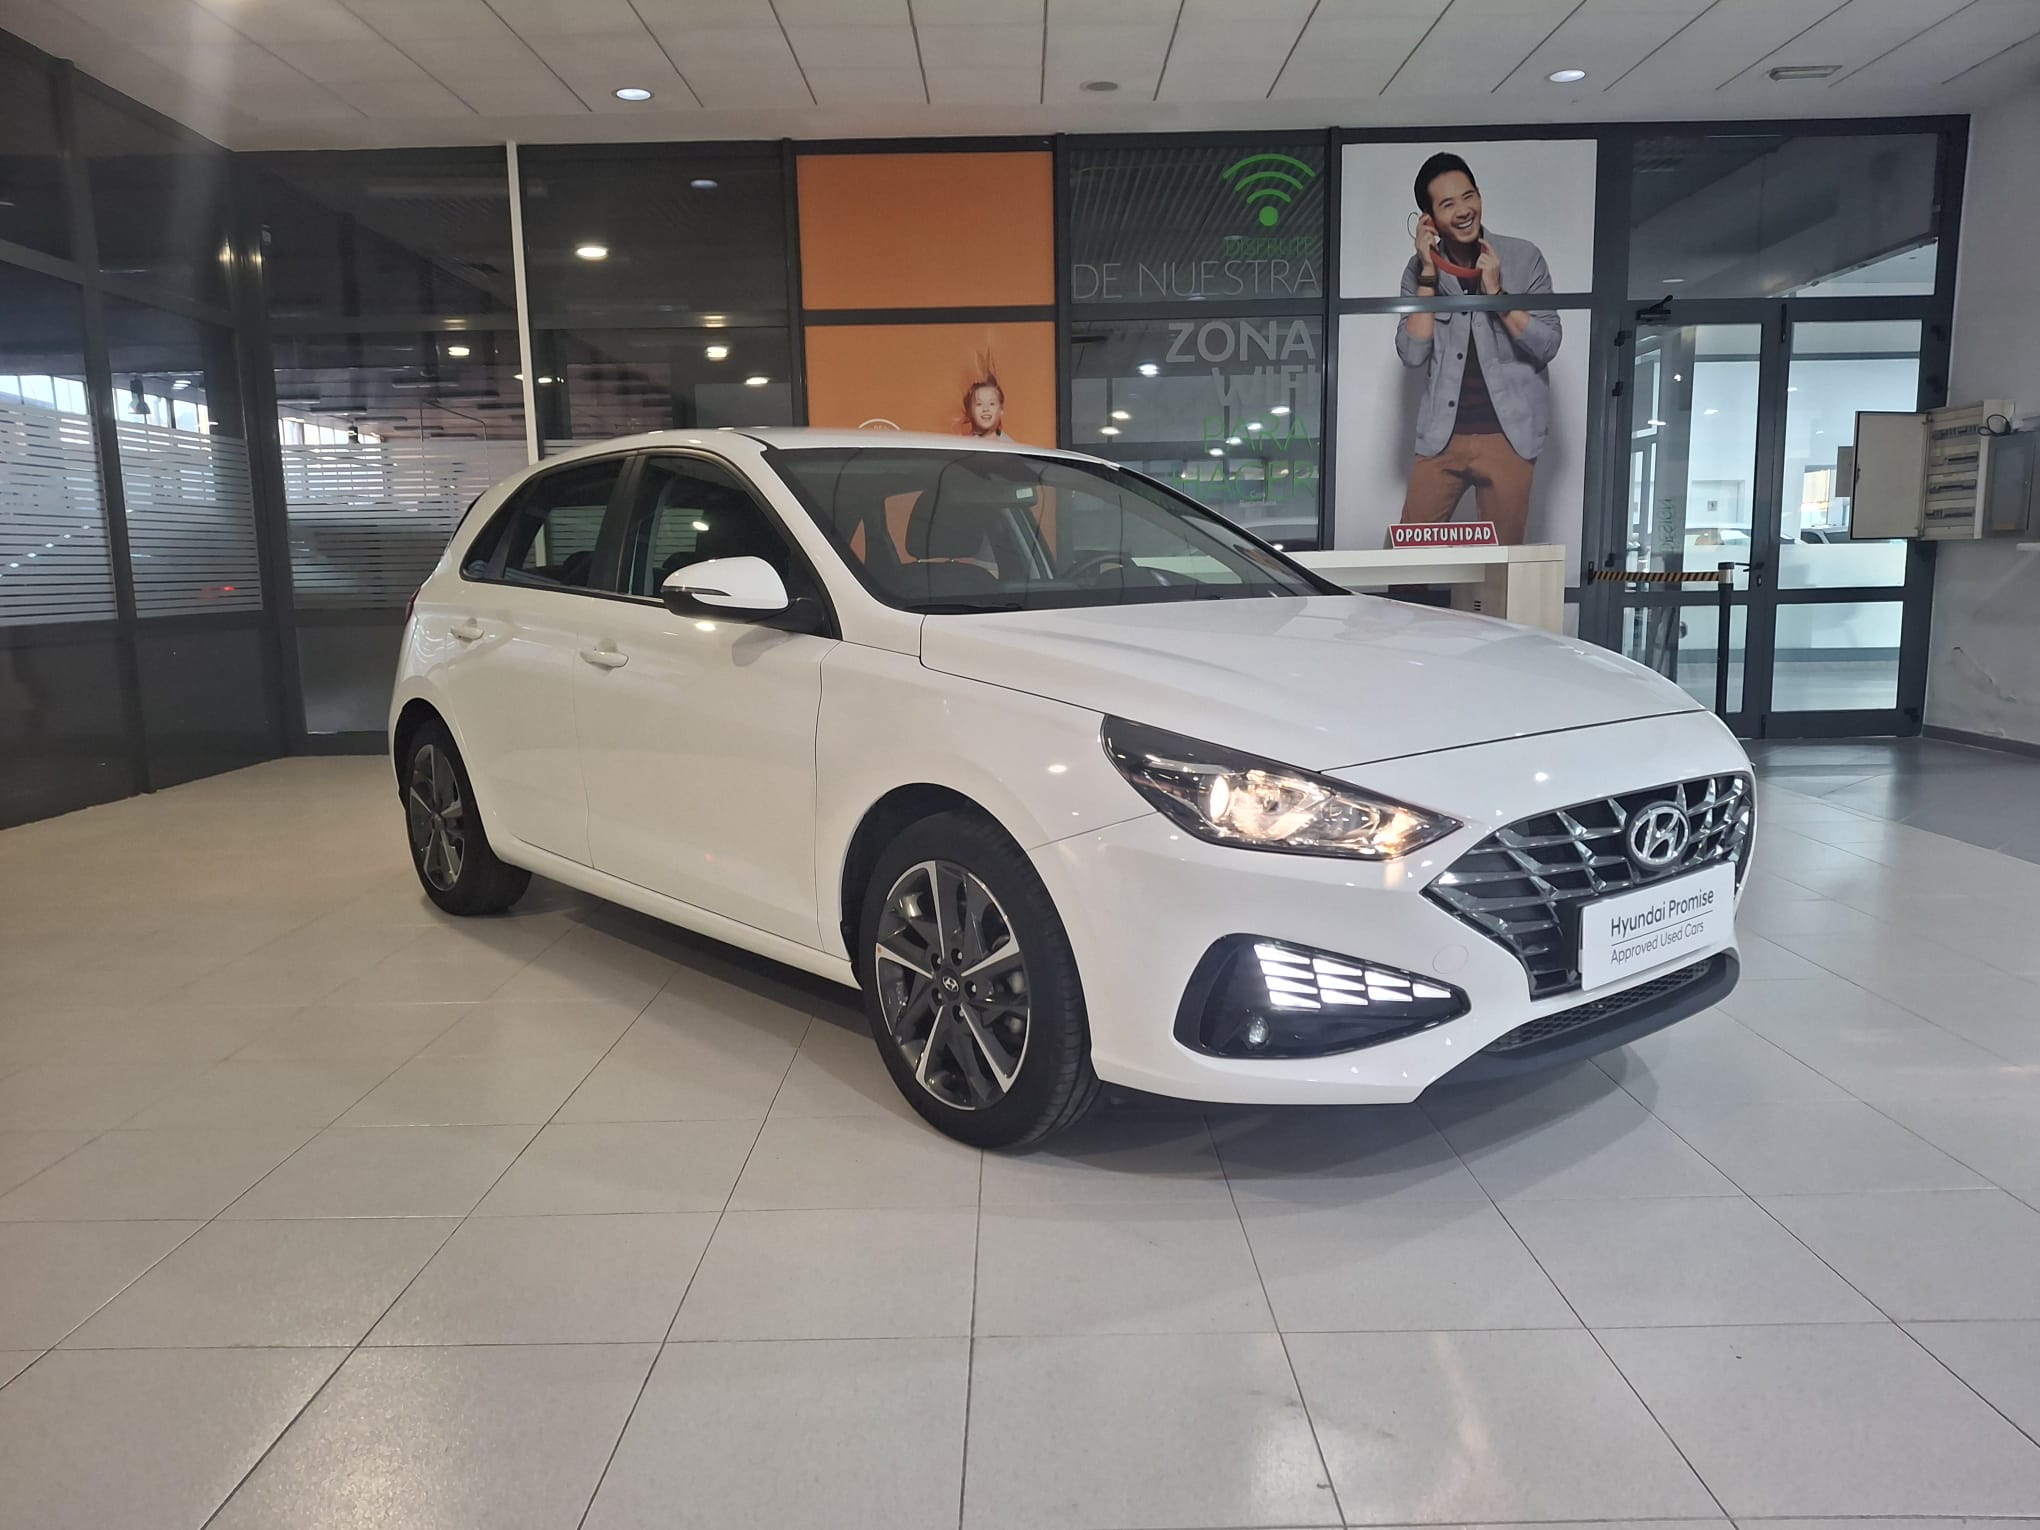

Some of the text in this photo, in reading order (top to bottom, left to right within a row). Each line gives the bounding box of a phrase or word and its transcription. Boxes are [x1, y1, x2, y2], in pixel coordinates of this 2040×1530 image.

[1072, 259, 1320, 299] DE NUESTRA
[1165, 319, 1316, 363] ZONA
[1211, 364, 1316, 407] WIFI
[1203, 414, 1312, 453] PARA
[1395, 526, 1491, 543] OPORTUNIDAD
[1611, 889, 1715, 938] Hyundai Promise
[1610, 921, 1705, 966] Approved Used Cars
